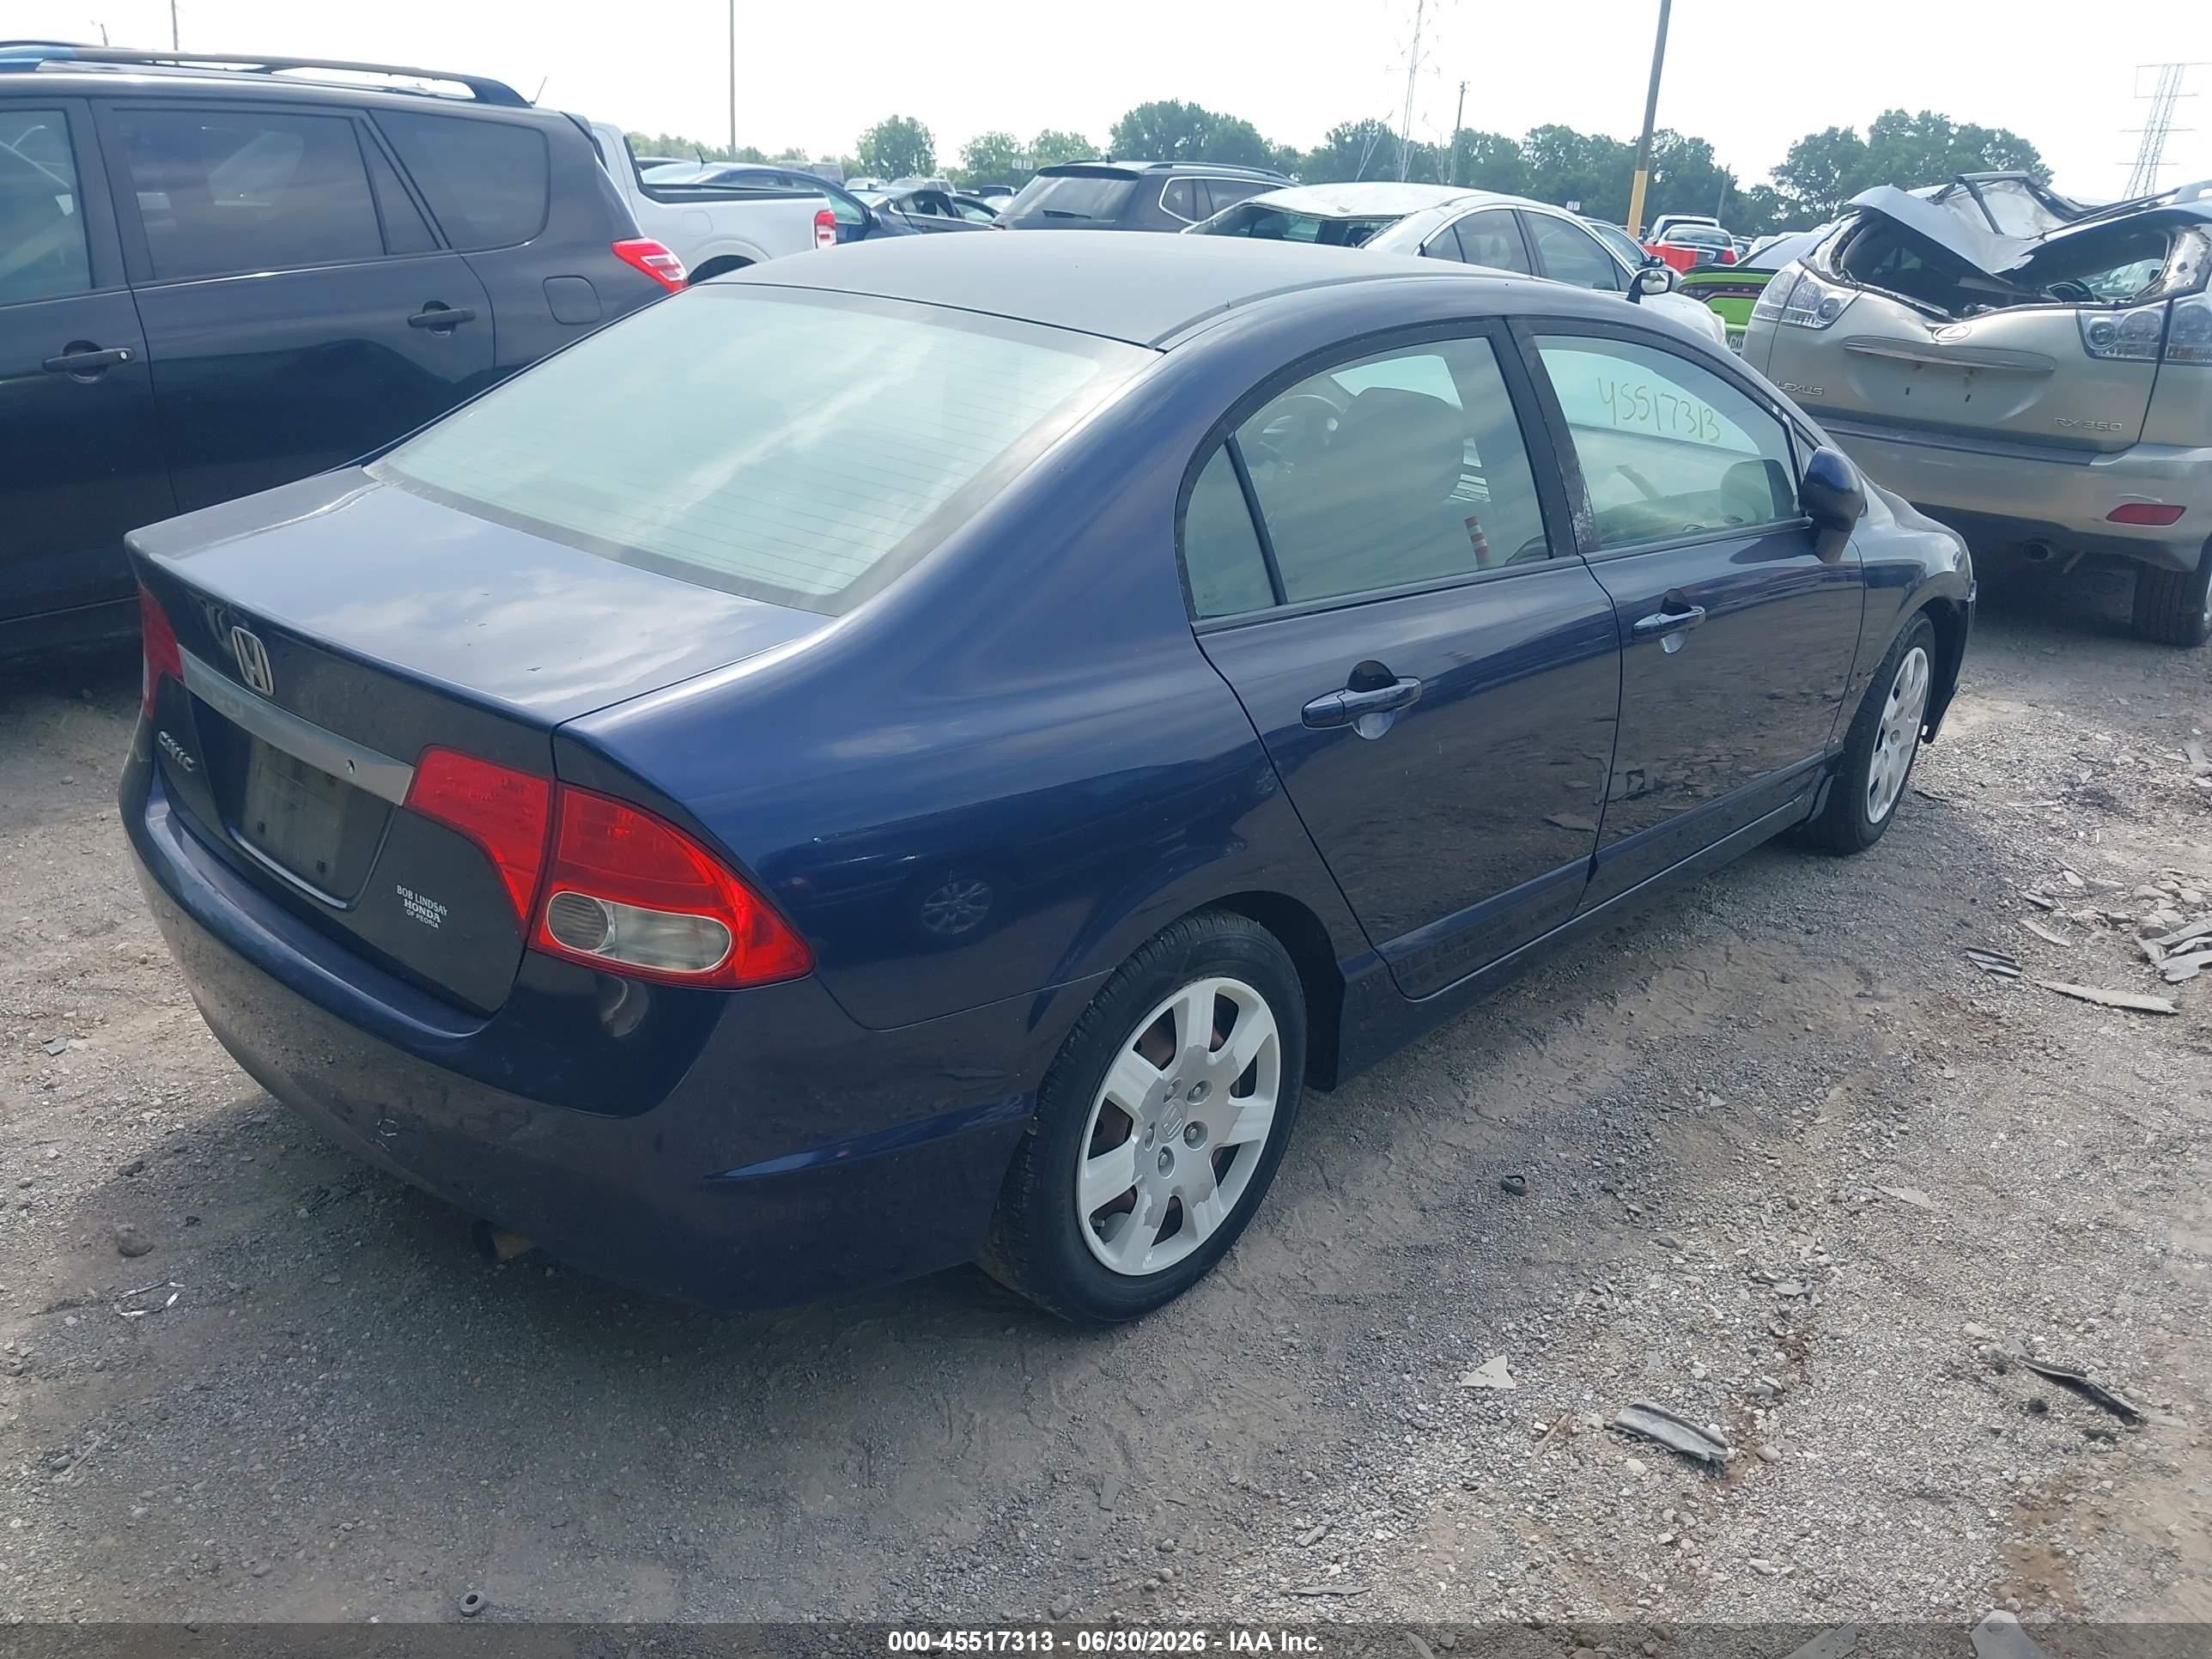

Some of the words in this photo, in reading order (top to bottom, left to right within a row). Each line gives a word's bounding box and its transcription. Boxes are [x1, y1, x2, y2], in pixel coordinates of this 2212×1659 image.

[1777, 380, 1824, 396] LEXUS
[1597, 377, 1721, 442] 45517313
[2082, 420, 2123, 431] 350
[158, 731, 195, 772] CIVIC
[397, 884, 413, 900] BOB
[415, 892, 447, 916] LINDSAY
[404, 898, 441, 923] HONDA
[416, 913, 439, 929] PEORIA
